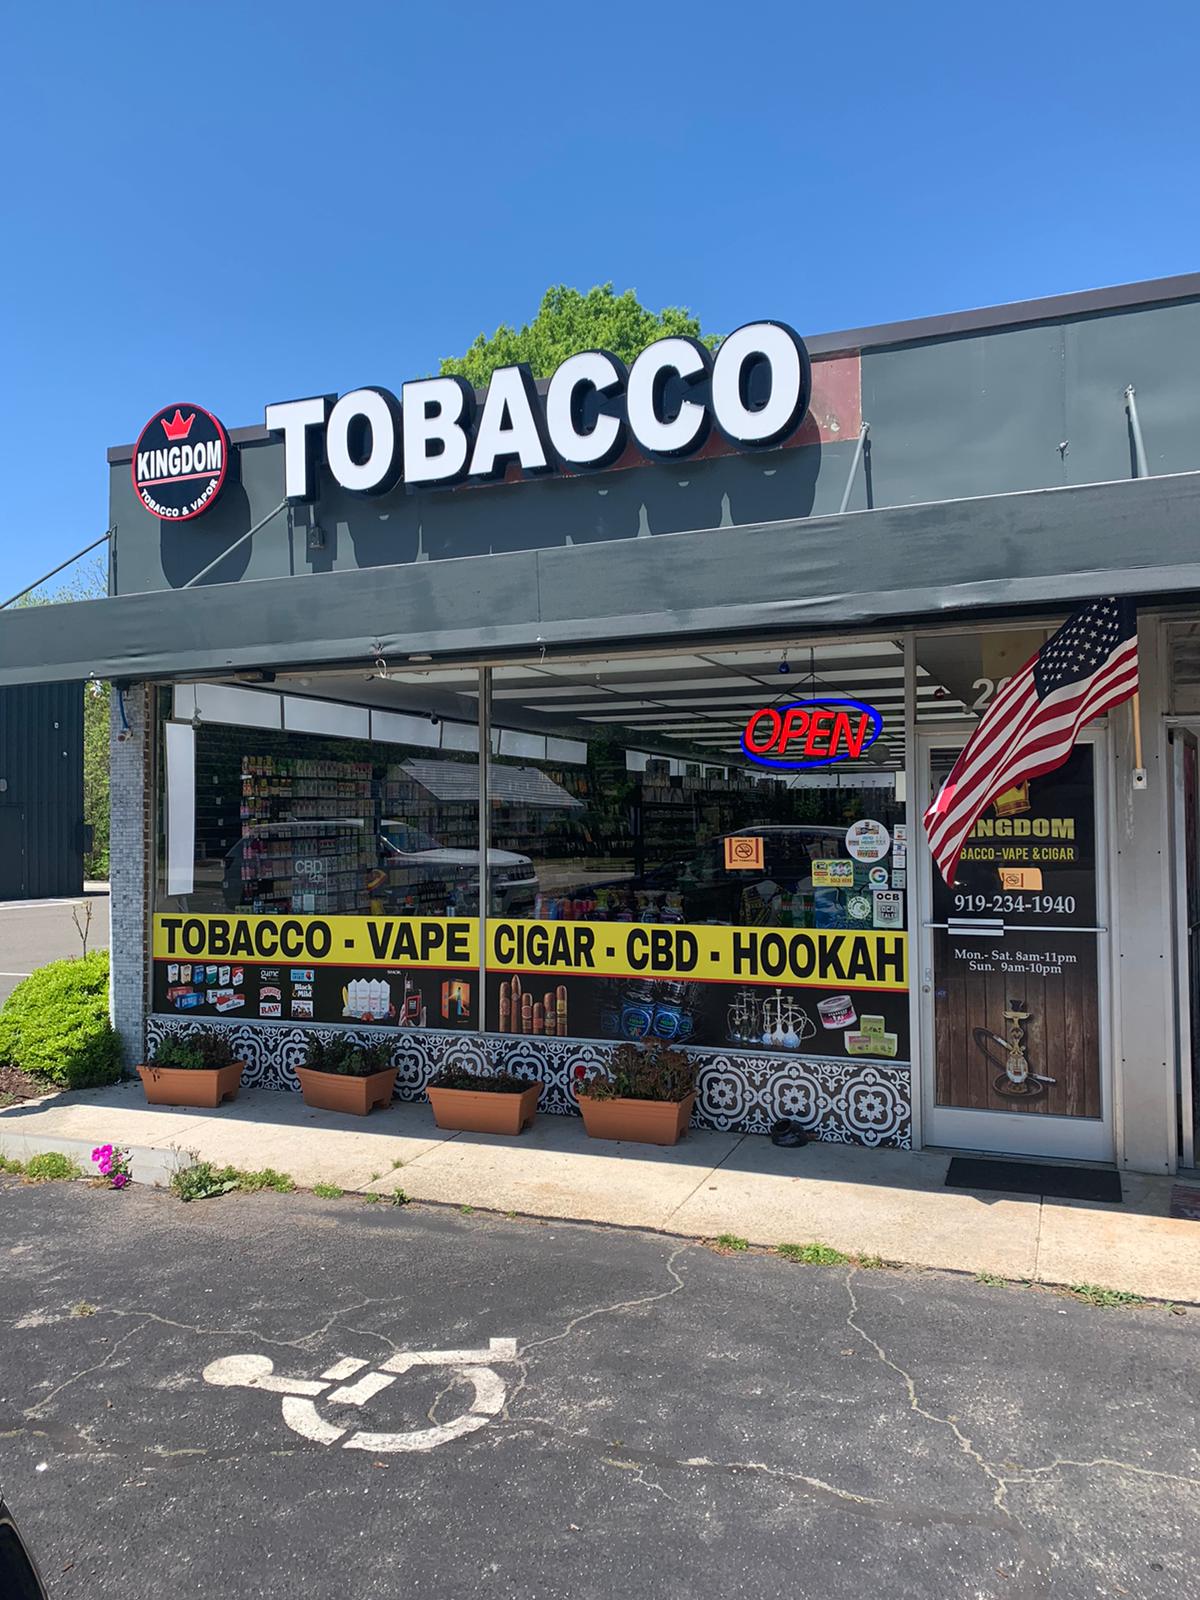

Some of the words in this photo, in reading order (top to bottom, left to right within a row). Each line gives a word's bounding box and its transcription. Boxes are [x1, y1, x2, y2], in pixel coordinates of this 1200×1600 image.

[266, 323, 801, 498] TOBACCO
[137, 440, 221, 481] KINGDOM
[141, 488, 179, 517] TOBACCO
[182, 506, 189, 516] &
[190, 478, 218, 511] VAPOR
[745, 708, 869, 758] OPEN
[968, 818, 1075, 839] NGDOM
[876, 893, 900, 901] OCB
[954, 894, 1076, 914] 919-234-1940
[161, 918, 332, 958] TOBACCO
[366, 922, 470, 962] VAPE
[494, 924, 595, 968] CIGAR
[626, 928, 698, 972] CBD
[732, 932, 905, 982] HOOKAH
[969, 960, 996, 972] Sun.
[1000, 961, 1062, 977] 9am-10pm
[991, 949, 1013, 961] Sat.
[1015, 950, 1077, 966] 8am-11pm
[261, 1004, 280, 1014] RAW
